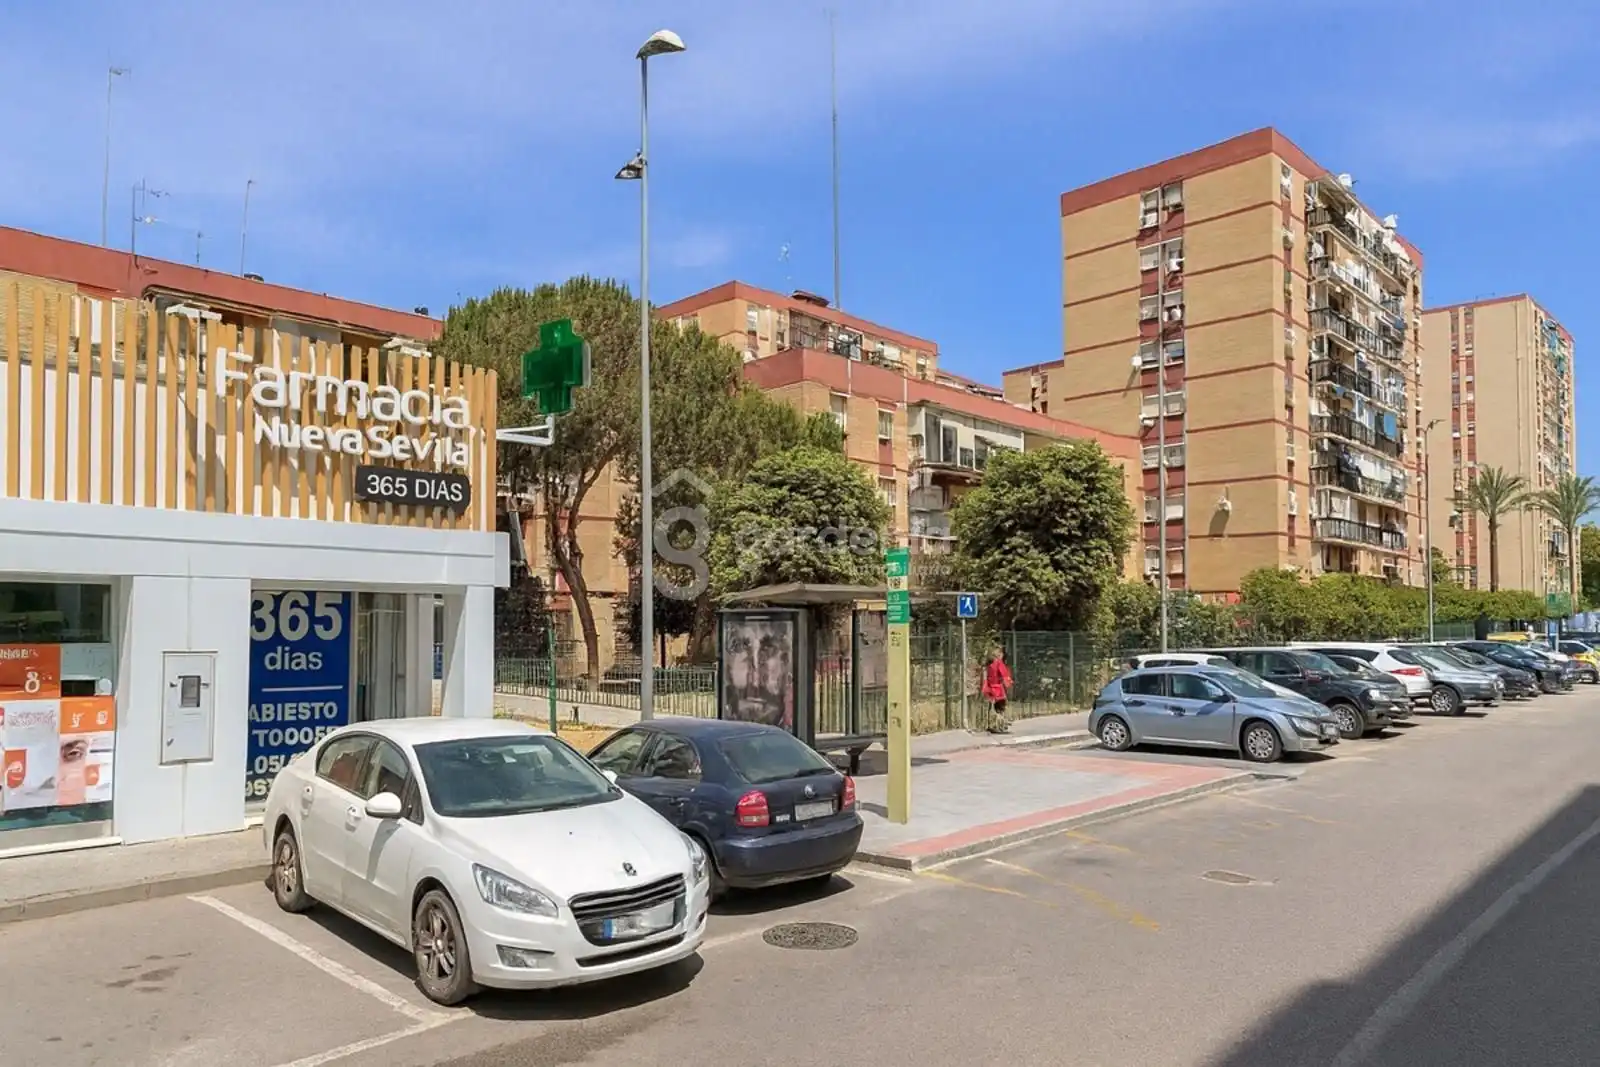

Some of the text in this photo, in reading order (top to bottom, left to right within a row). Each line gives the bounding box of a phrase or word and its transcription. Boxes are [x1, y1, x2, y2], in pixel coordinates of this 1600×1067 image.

[215, 347, 470, 428] Farmacia
[254, 413, 469, 466] Nueva Sevilla
[367, 474, 463, 502] 365 DIAS
[250, 591, 343, 641] 365
[264, 646, 323, 671] dias
[248, 702, 338, 722] ABIESTO
